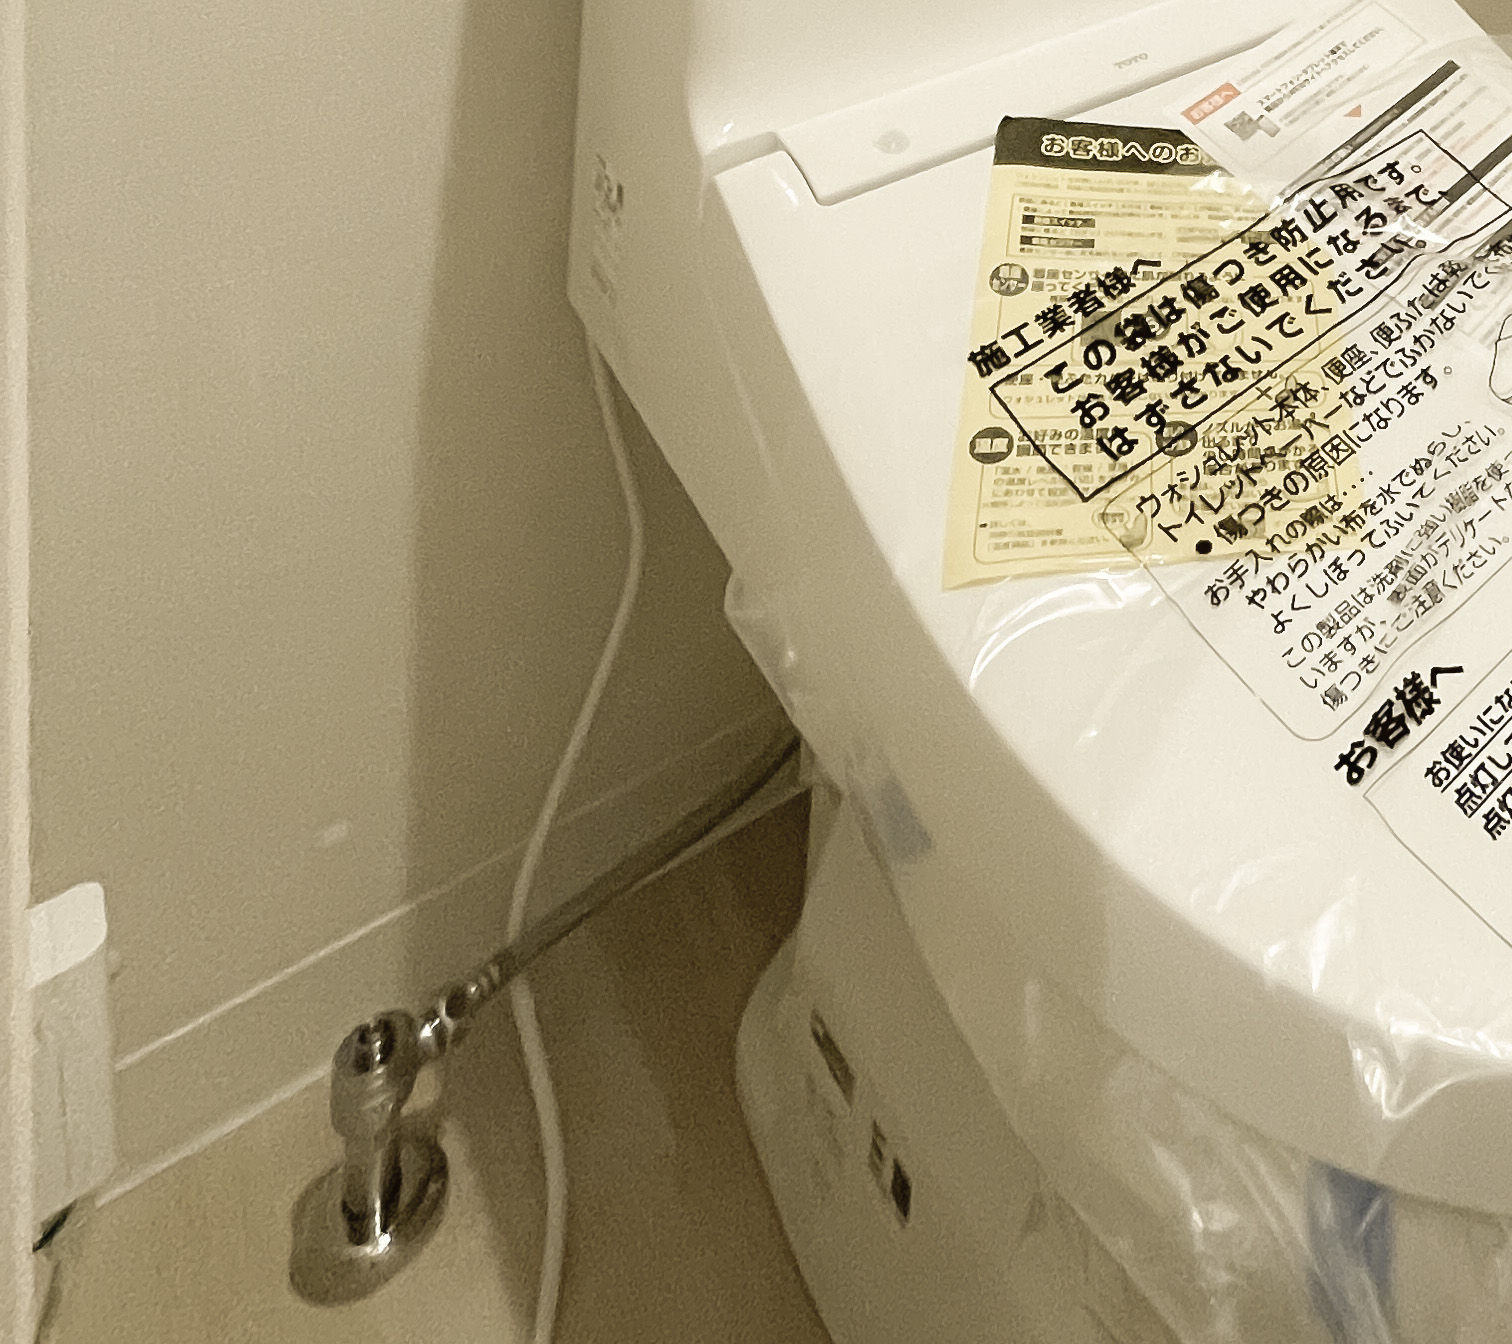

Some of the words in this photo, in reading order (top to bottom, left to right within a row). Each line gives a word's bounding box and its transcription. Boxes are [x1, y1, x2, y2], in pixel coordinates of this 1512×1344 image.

[1041, 133, 1217, 166] お客様へのお
[967, 258, 1163, 378] 施工業者様へ
[1333, 664, 1465, 787] お客様へ
